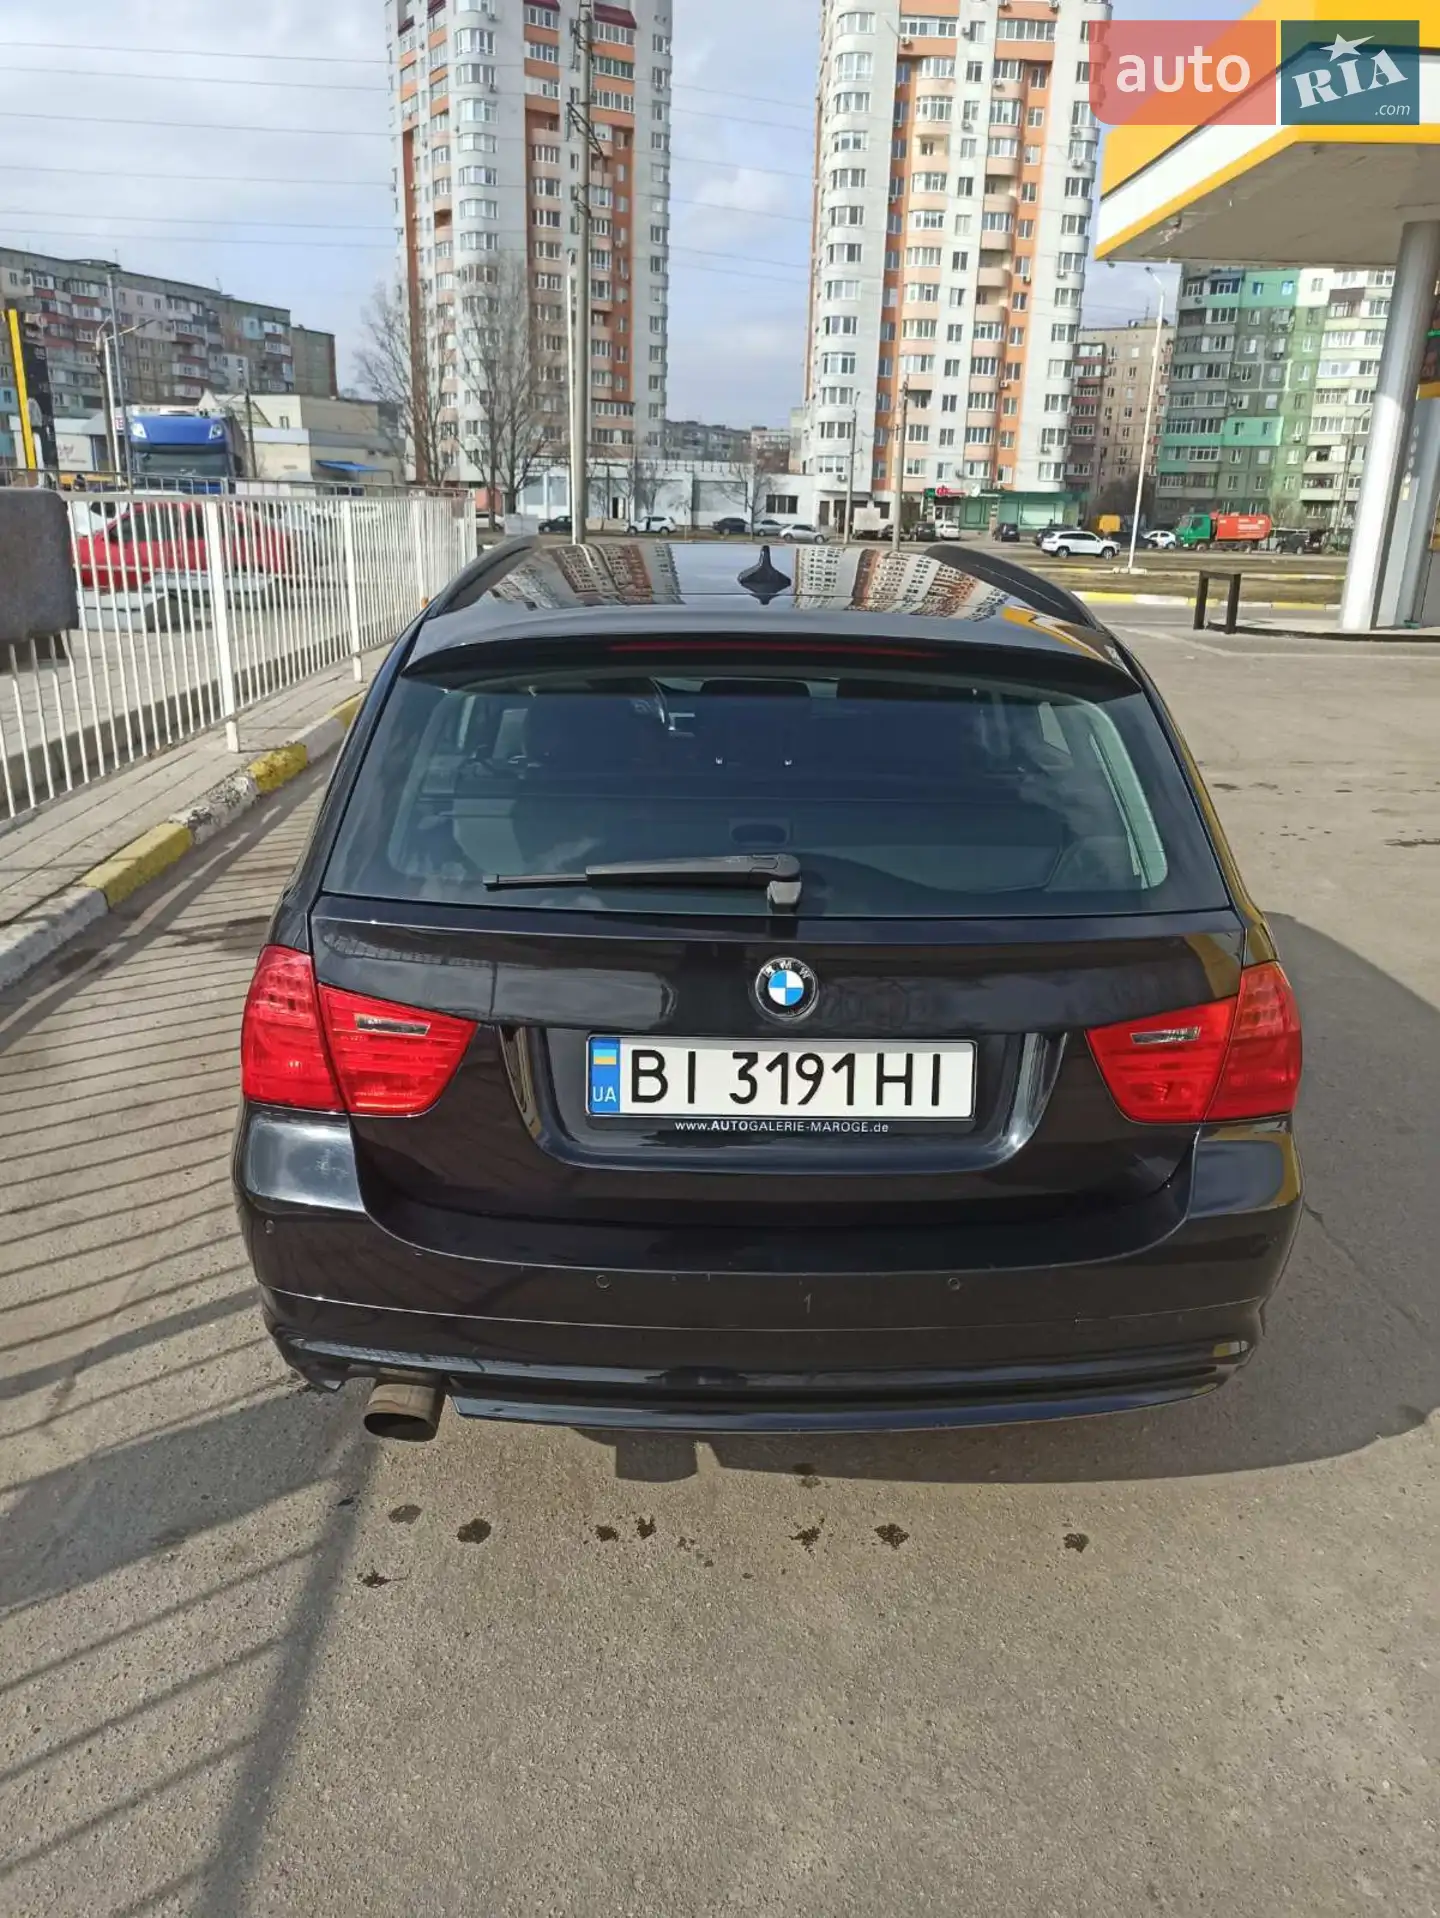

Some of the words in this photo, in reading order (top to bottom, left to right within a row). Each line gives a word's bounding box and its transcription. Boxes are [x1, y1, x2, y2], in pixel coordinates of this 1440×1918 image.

[631, 1049, 697, 1105] BI
[592, 1086, 617, 1102] UA
[674, 1120, 889, 1134] www.AUTOGALERIE-MAROGE.de
